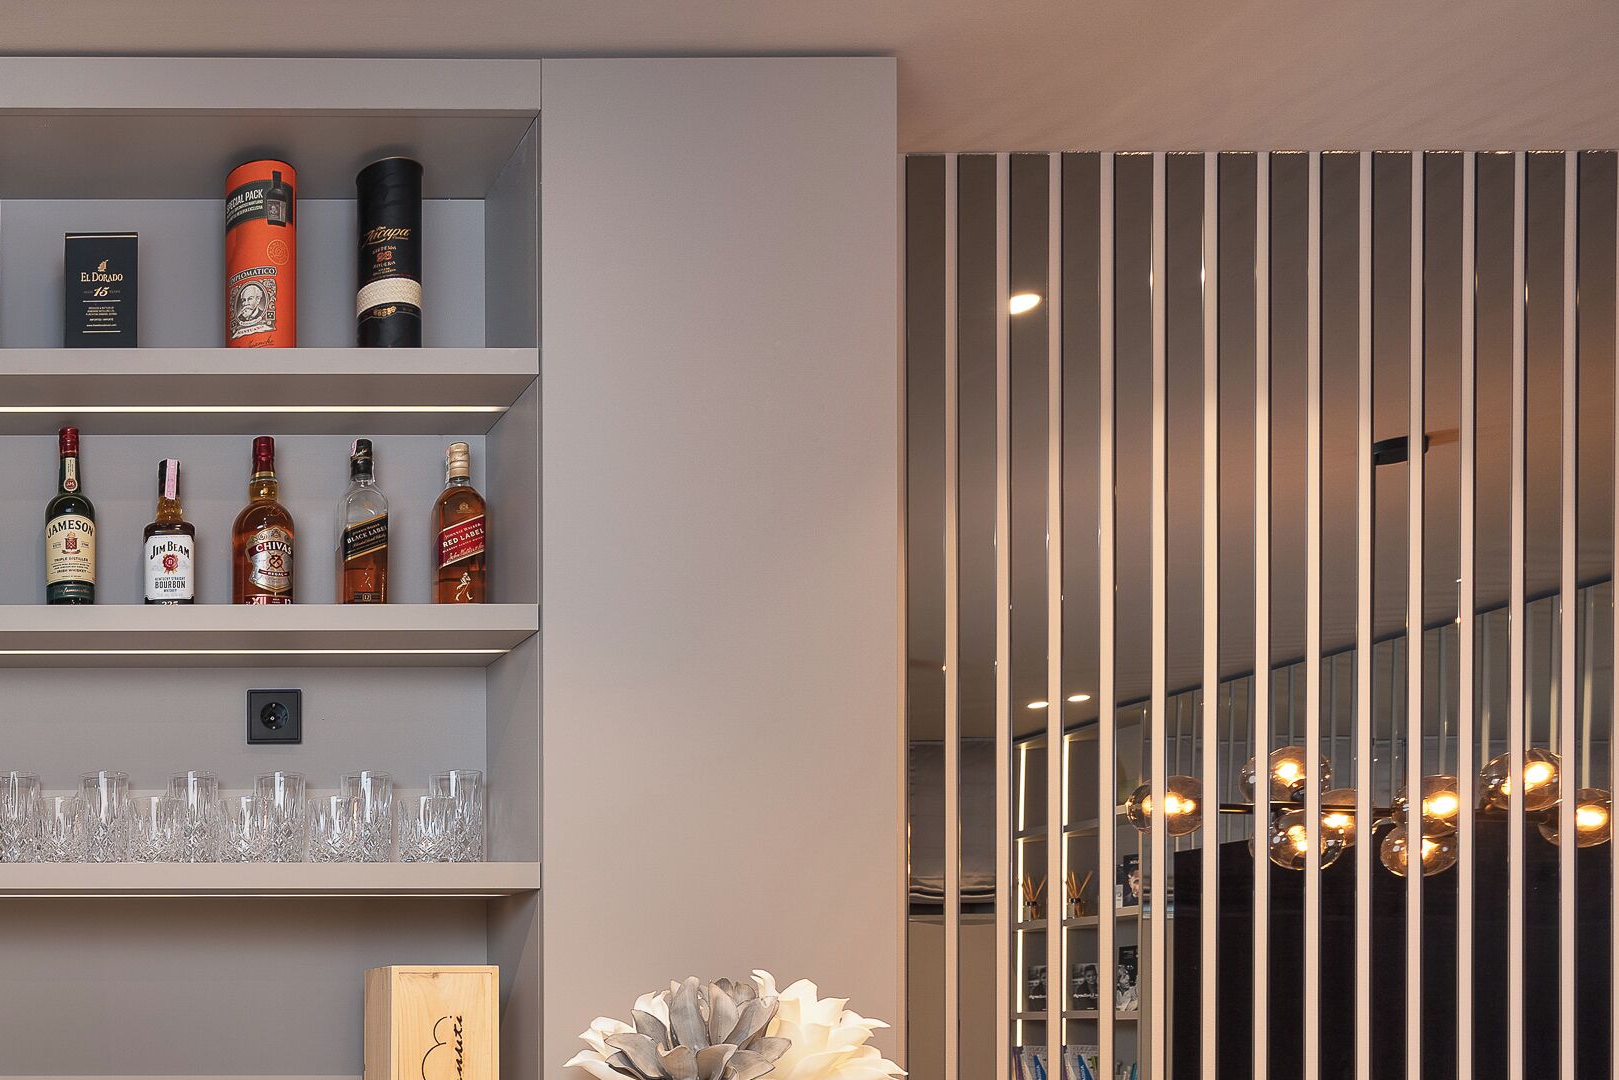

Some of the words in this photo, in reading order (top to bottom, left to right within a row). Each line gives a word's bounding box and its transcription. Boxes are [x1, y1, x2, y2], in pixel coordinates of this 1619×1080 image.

[226, 194, 244, 214] SPECIAL
[245, 188, 264, 202] PACK
[80, 272, 91, 282] EL
[92, 272, 123, 283] DORADO
[93, 286, 110, 297] 15
[47, 519, 94, 539] JAMESON
[346, 531, 368, 544] BLACK
[368, 525, 387, 537] LABEL
[442, 537, 459, 548] RED
[460, 528, 484, 541] LABEL
[150, 544, 165, 560] JIM
[167, 540, 190, 560] BEAM
[256, 541, 292, 555] CHIVAS
[154, 580, 186, 589] BOURBON
